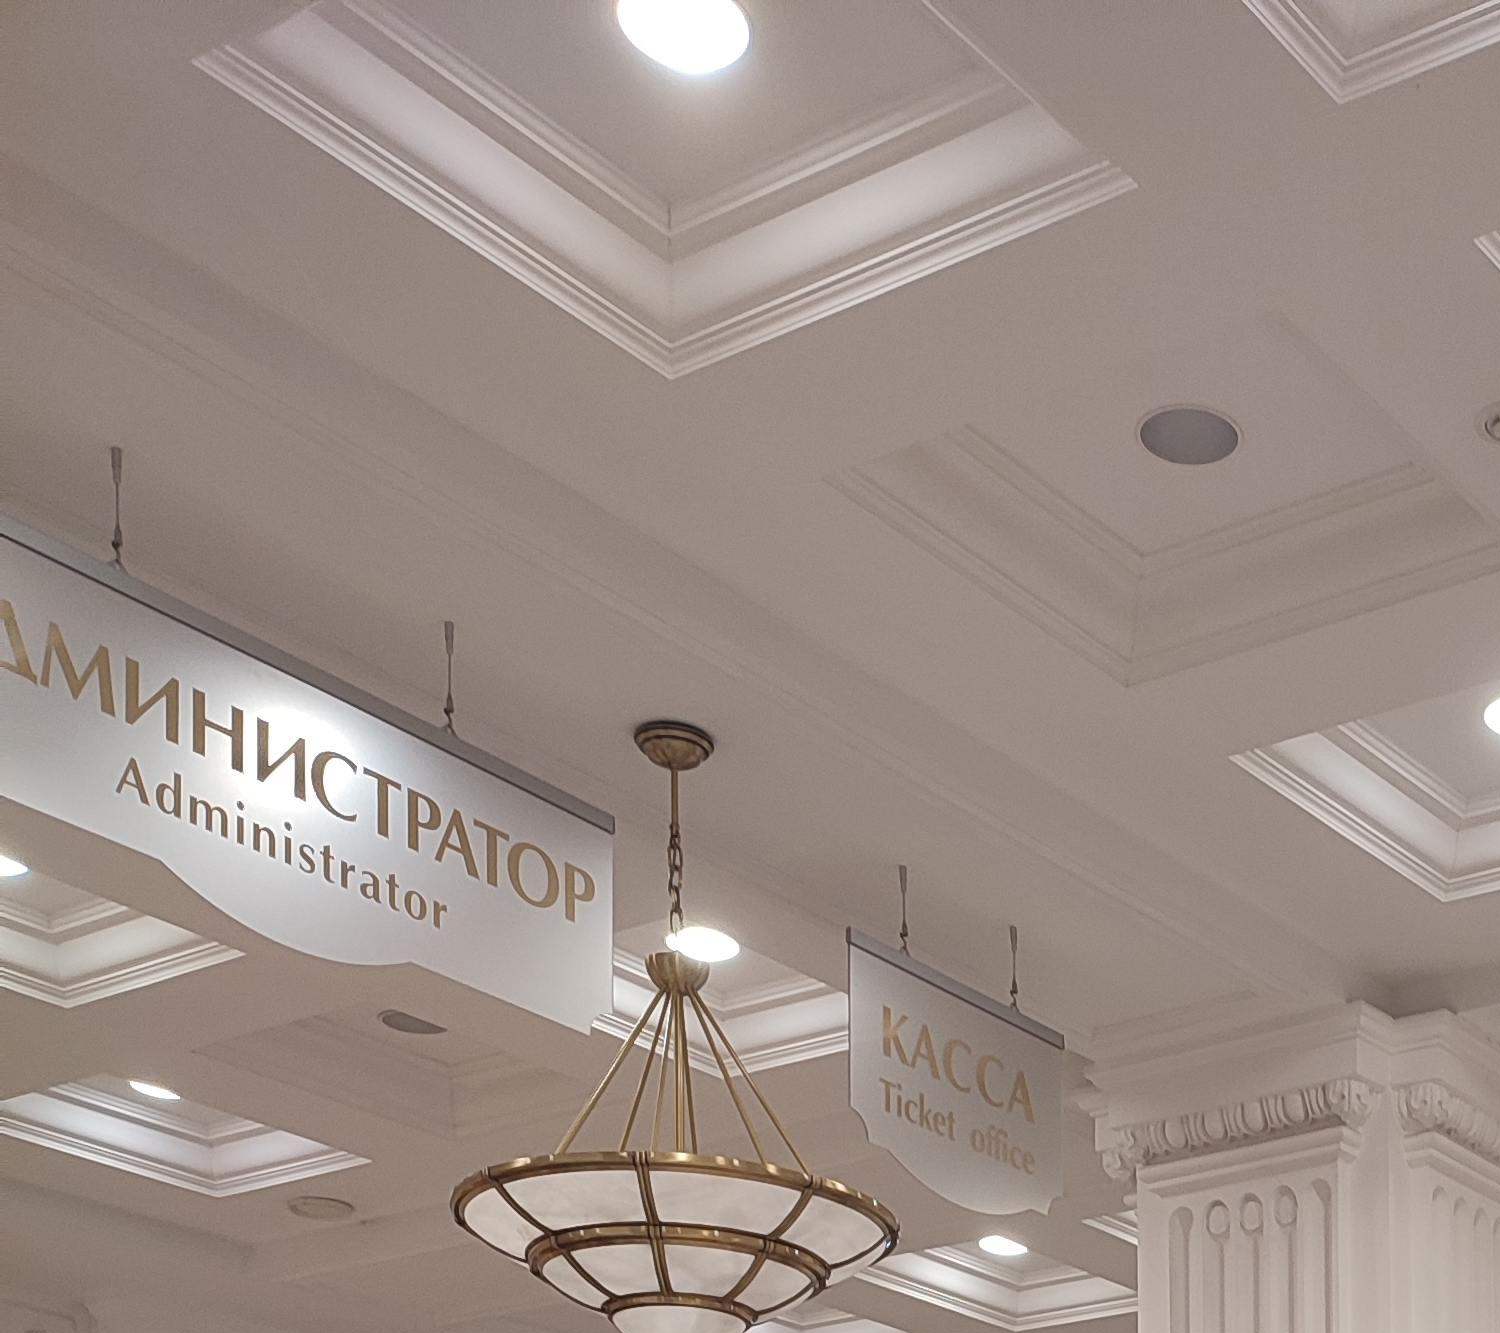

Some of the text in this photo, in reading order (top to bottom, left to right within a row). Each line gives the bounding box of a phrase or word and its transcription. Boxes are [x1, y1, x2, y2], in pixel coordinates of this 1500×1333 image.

[115, 757, 448, 929] Administrator
[881, 1005, 1035, 1124] КАССА
[879, 1078, 1036, 1174] Ticket office
